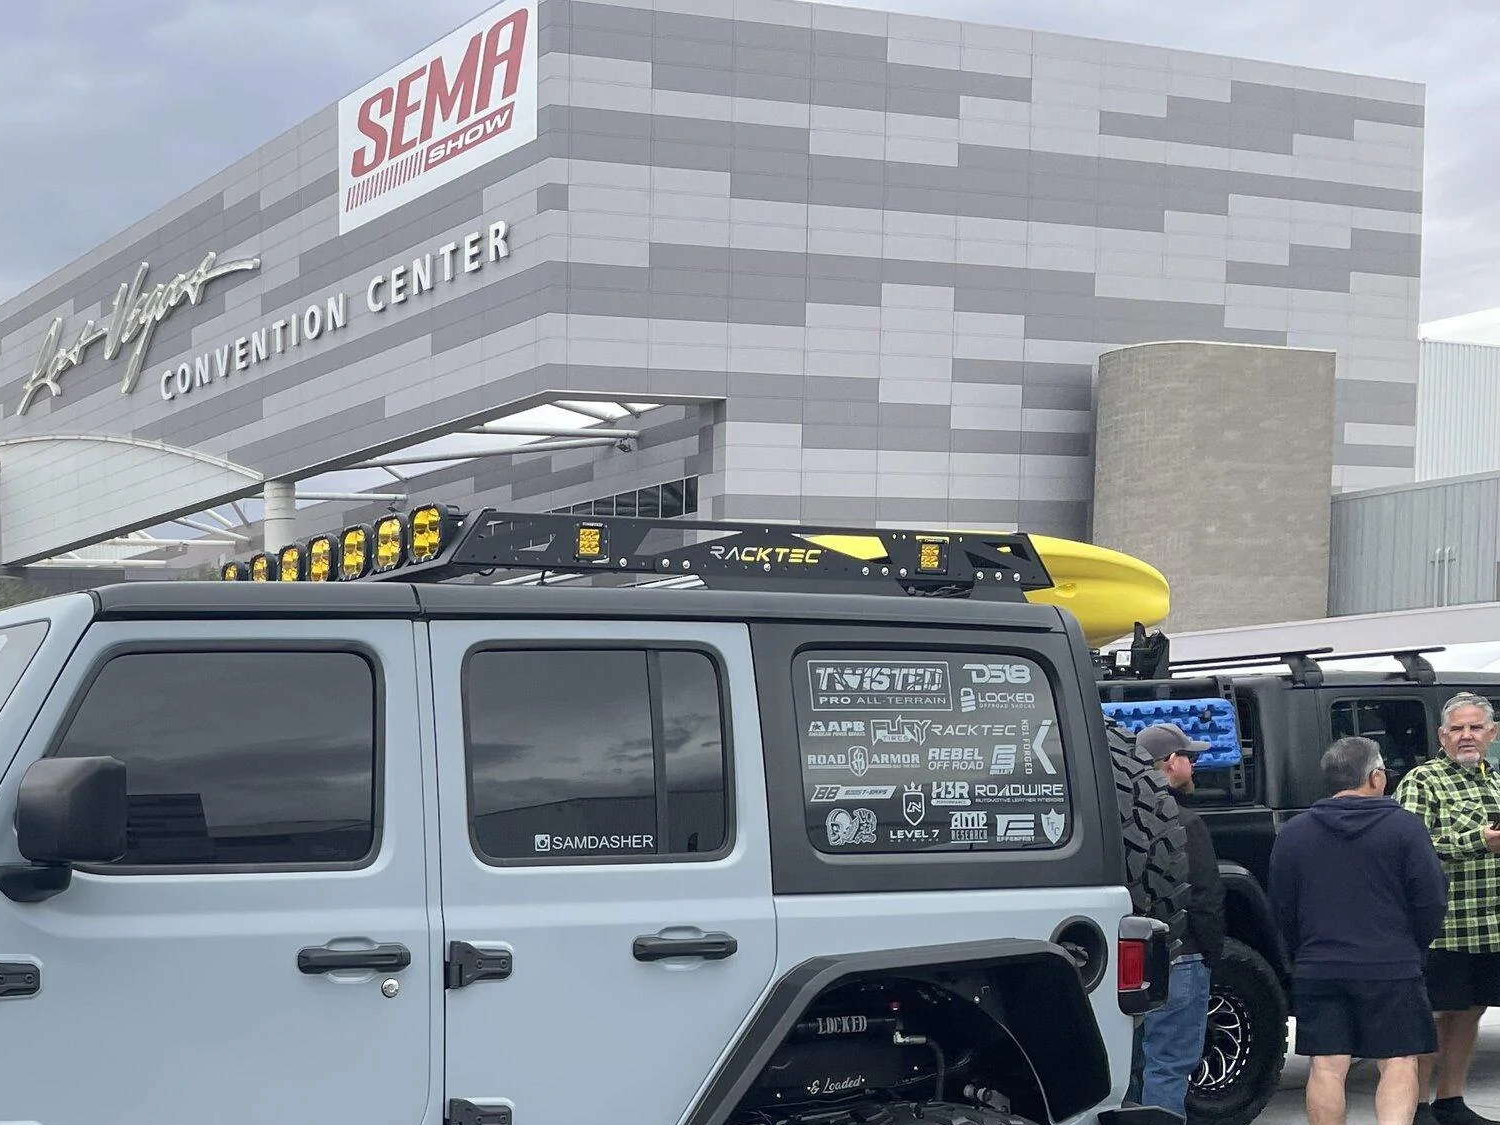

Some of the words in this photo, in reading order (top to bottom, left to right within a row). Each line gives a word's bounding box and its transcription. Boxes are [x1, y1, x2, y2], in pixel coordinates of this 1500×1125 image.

[350, 7, 529, 178] SEMA
[427, 108, 512, 164] SHOW
[159, 293, 348, 401] CONVENTION
[366, 220, 511, 313] CENTER
[103, 251, 262, 394] Vegas
[709, 545, 822, 563] RACKTEC
[815, 667, 943, 691] TWISTED
[962, 663, 1032, 684] DS18
[819, 696, 851, 705] PRO
[856, 696, 947, 705] ALL-TERRAIN
[978, 692, 1035, 703] LOCKED
[870, 715, 932, 746] FURY
[930, 724, 1017, 736] RACKTEC
[807, 754, 846, 765] ROAD
[870, 753, 920, 764] ARMOR
[927, 747, 984, 760] REBEL
[1022, 738, 1033, 775] FORGED
[928, 761, 950, 771] OFF
[952, 761, 984, 770] ROAD
[931, 781, 970, 799] H3R
[974, 784, 1064, 797] ROADWIRE
[950, 812, 988, 829] AMP
[552, 835, 654, 849] SAMDASHER
[889, 829, 929, 839] LEVEL
[931, 829, 940, 838] 7
[951, 829, 988, 840] RESEARCH
[816, 1015, 867, 1034] LOCKED
[822, 1075, 862, 1094] Loaded
